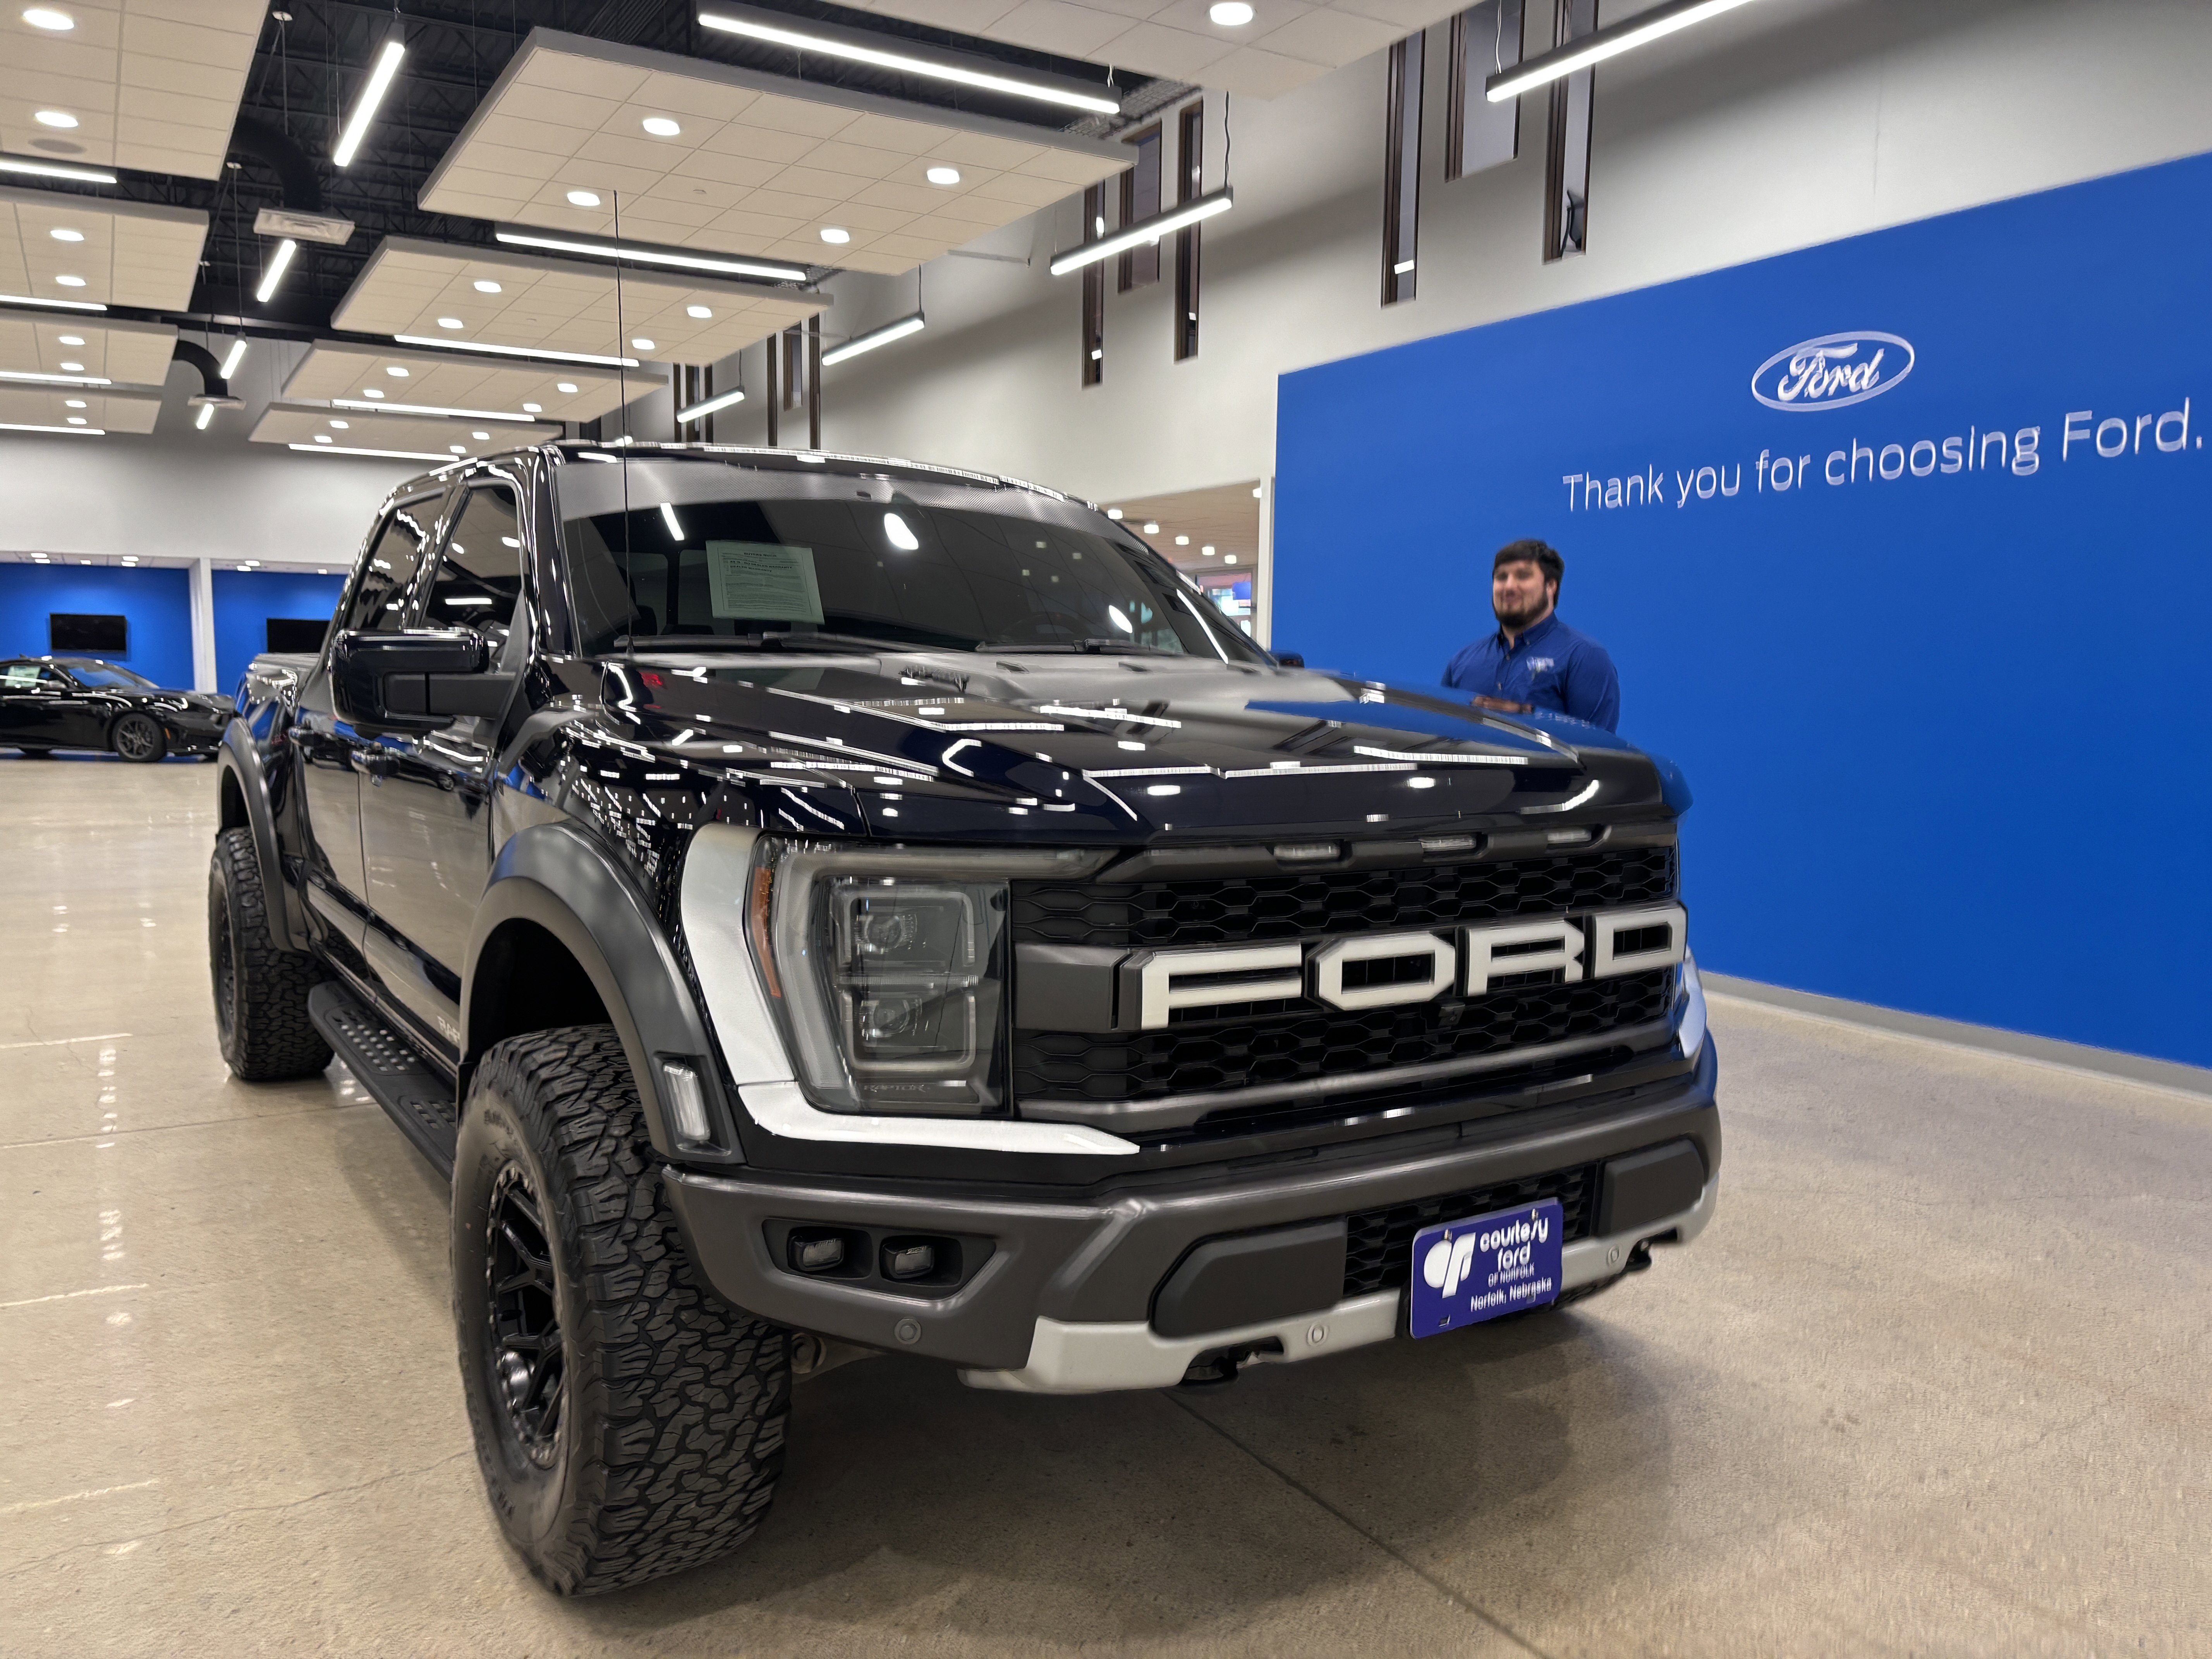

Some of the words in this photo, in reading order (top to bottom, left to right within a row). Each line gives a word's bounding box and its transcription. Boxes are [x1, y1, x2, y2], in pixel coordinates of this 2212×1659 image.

[1777, 342, 1885, 402] Ford
[1562, 464, 1664, 512] Thank
[1676, 466, 1741, 509] you
[1755, 449, 1811, 493] for
[1825, 425, 2041, 486] choosing
[2063, 397, 2203, 461] Ford.
[1141, 905, 1686, 1030] FORD
[864, 1083, 927, 1093] RAPTOR
[1480, 1217, 1548, 1252] courtesy
[1498, 1241, 1530, 1273] ford
[1470, 1288, 1506, 1312] Norfolk,
[1510, 1277, 1552, 1302] Nebraska
